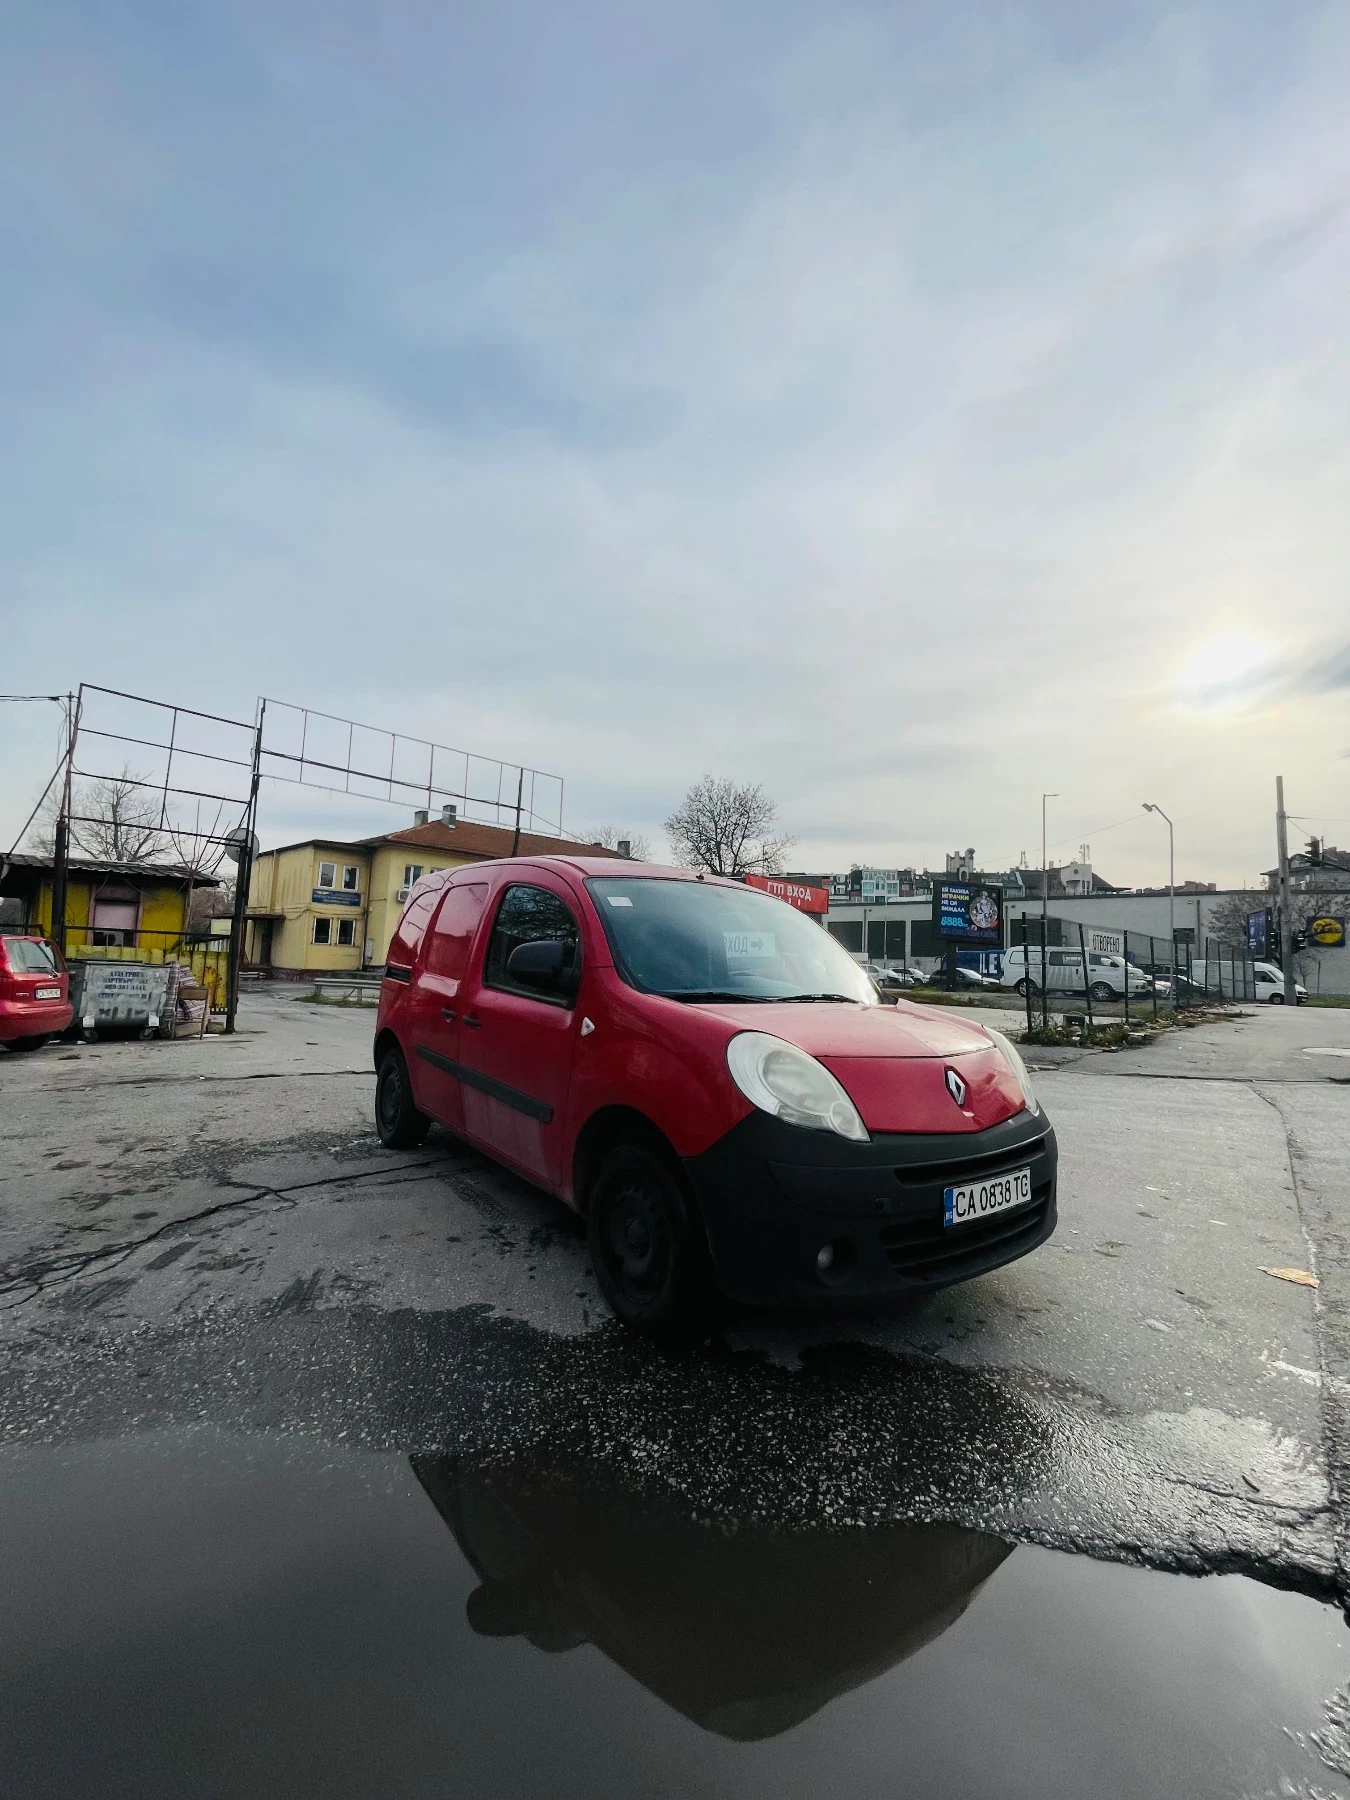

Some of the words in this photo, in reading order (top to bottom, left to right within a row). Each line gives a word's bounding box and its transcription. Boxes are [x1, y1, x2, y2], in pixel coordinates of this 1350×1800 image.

[767, 881, 784, 895] ГТП
[787, 885, 812, 902] ВХОД
[1092, 933, 1120, 953] ОТВОРЕНО
[955, 1189, 977, 1217] CA
[980, 1180, 1011, 1211] 0838
